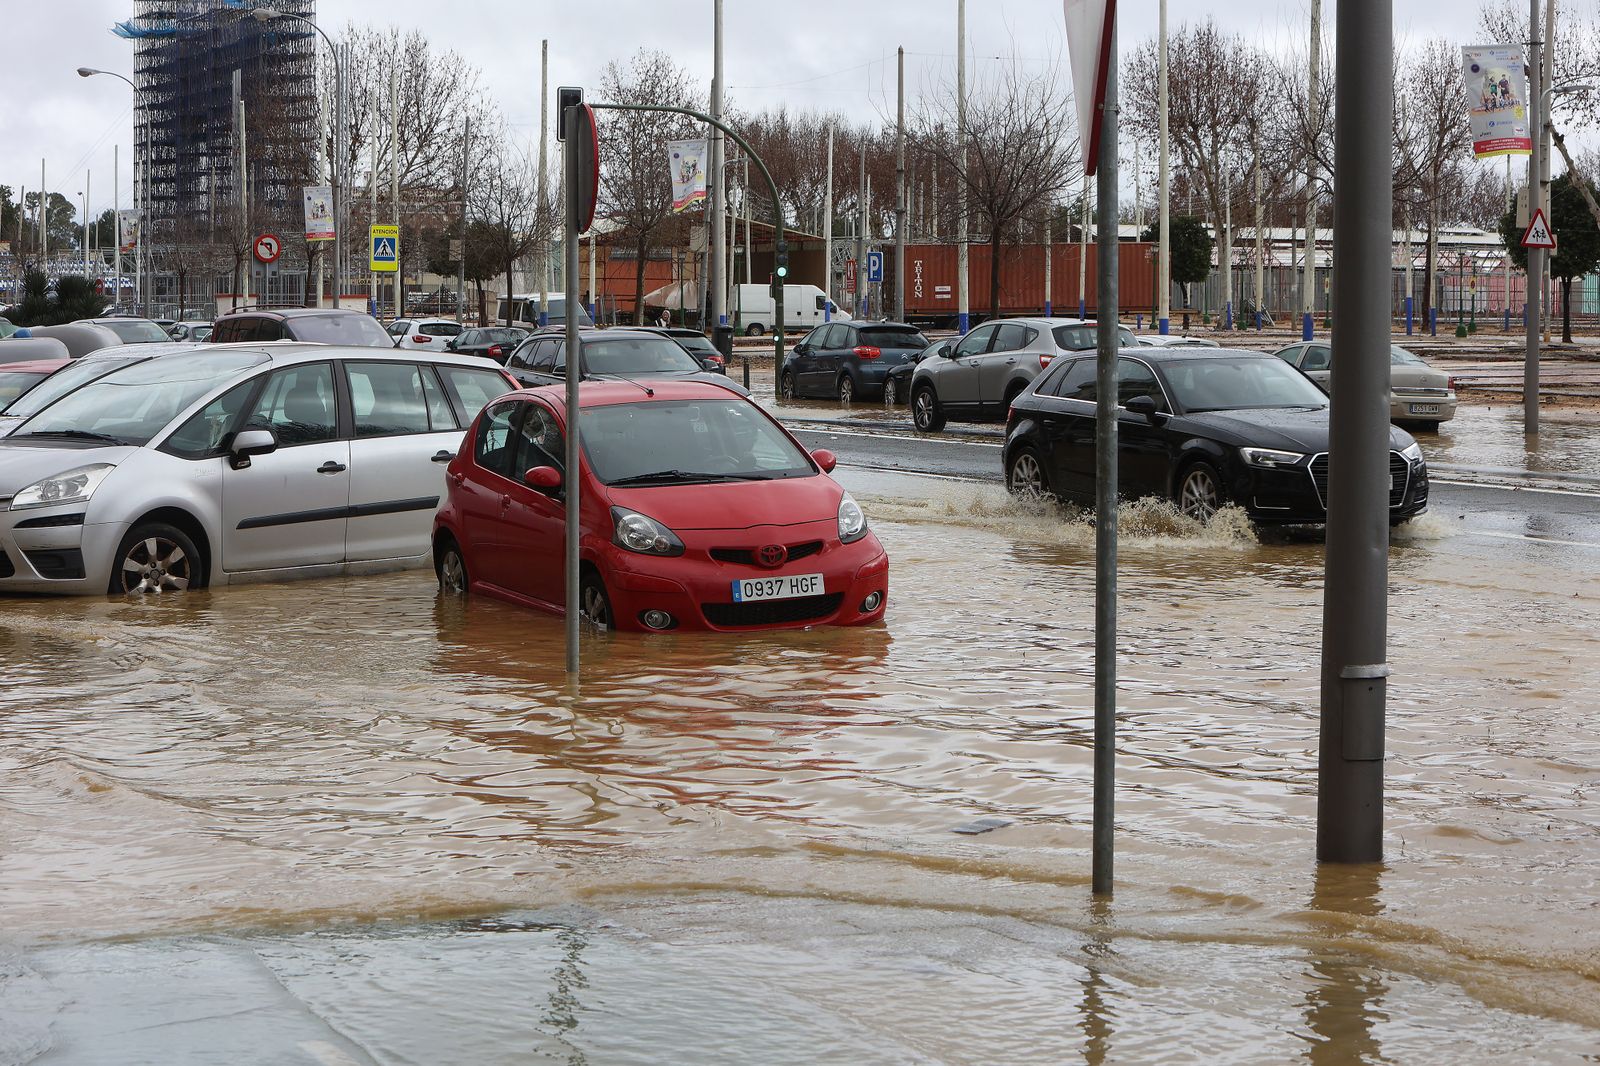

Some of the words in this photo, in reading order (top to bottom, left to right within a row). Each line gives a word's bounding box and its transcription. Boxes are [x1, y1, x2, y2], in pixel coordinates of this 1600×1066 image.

[869, 255, 880, 279] P
[914, 260, 923, 298] TRITON
[744, 579, 783, 597] 0937
[790, 576, 818, 594] HGF
